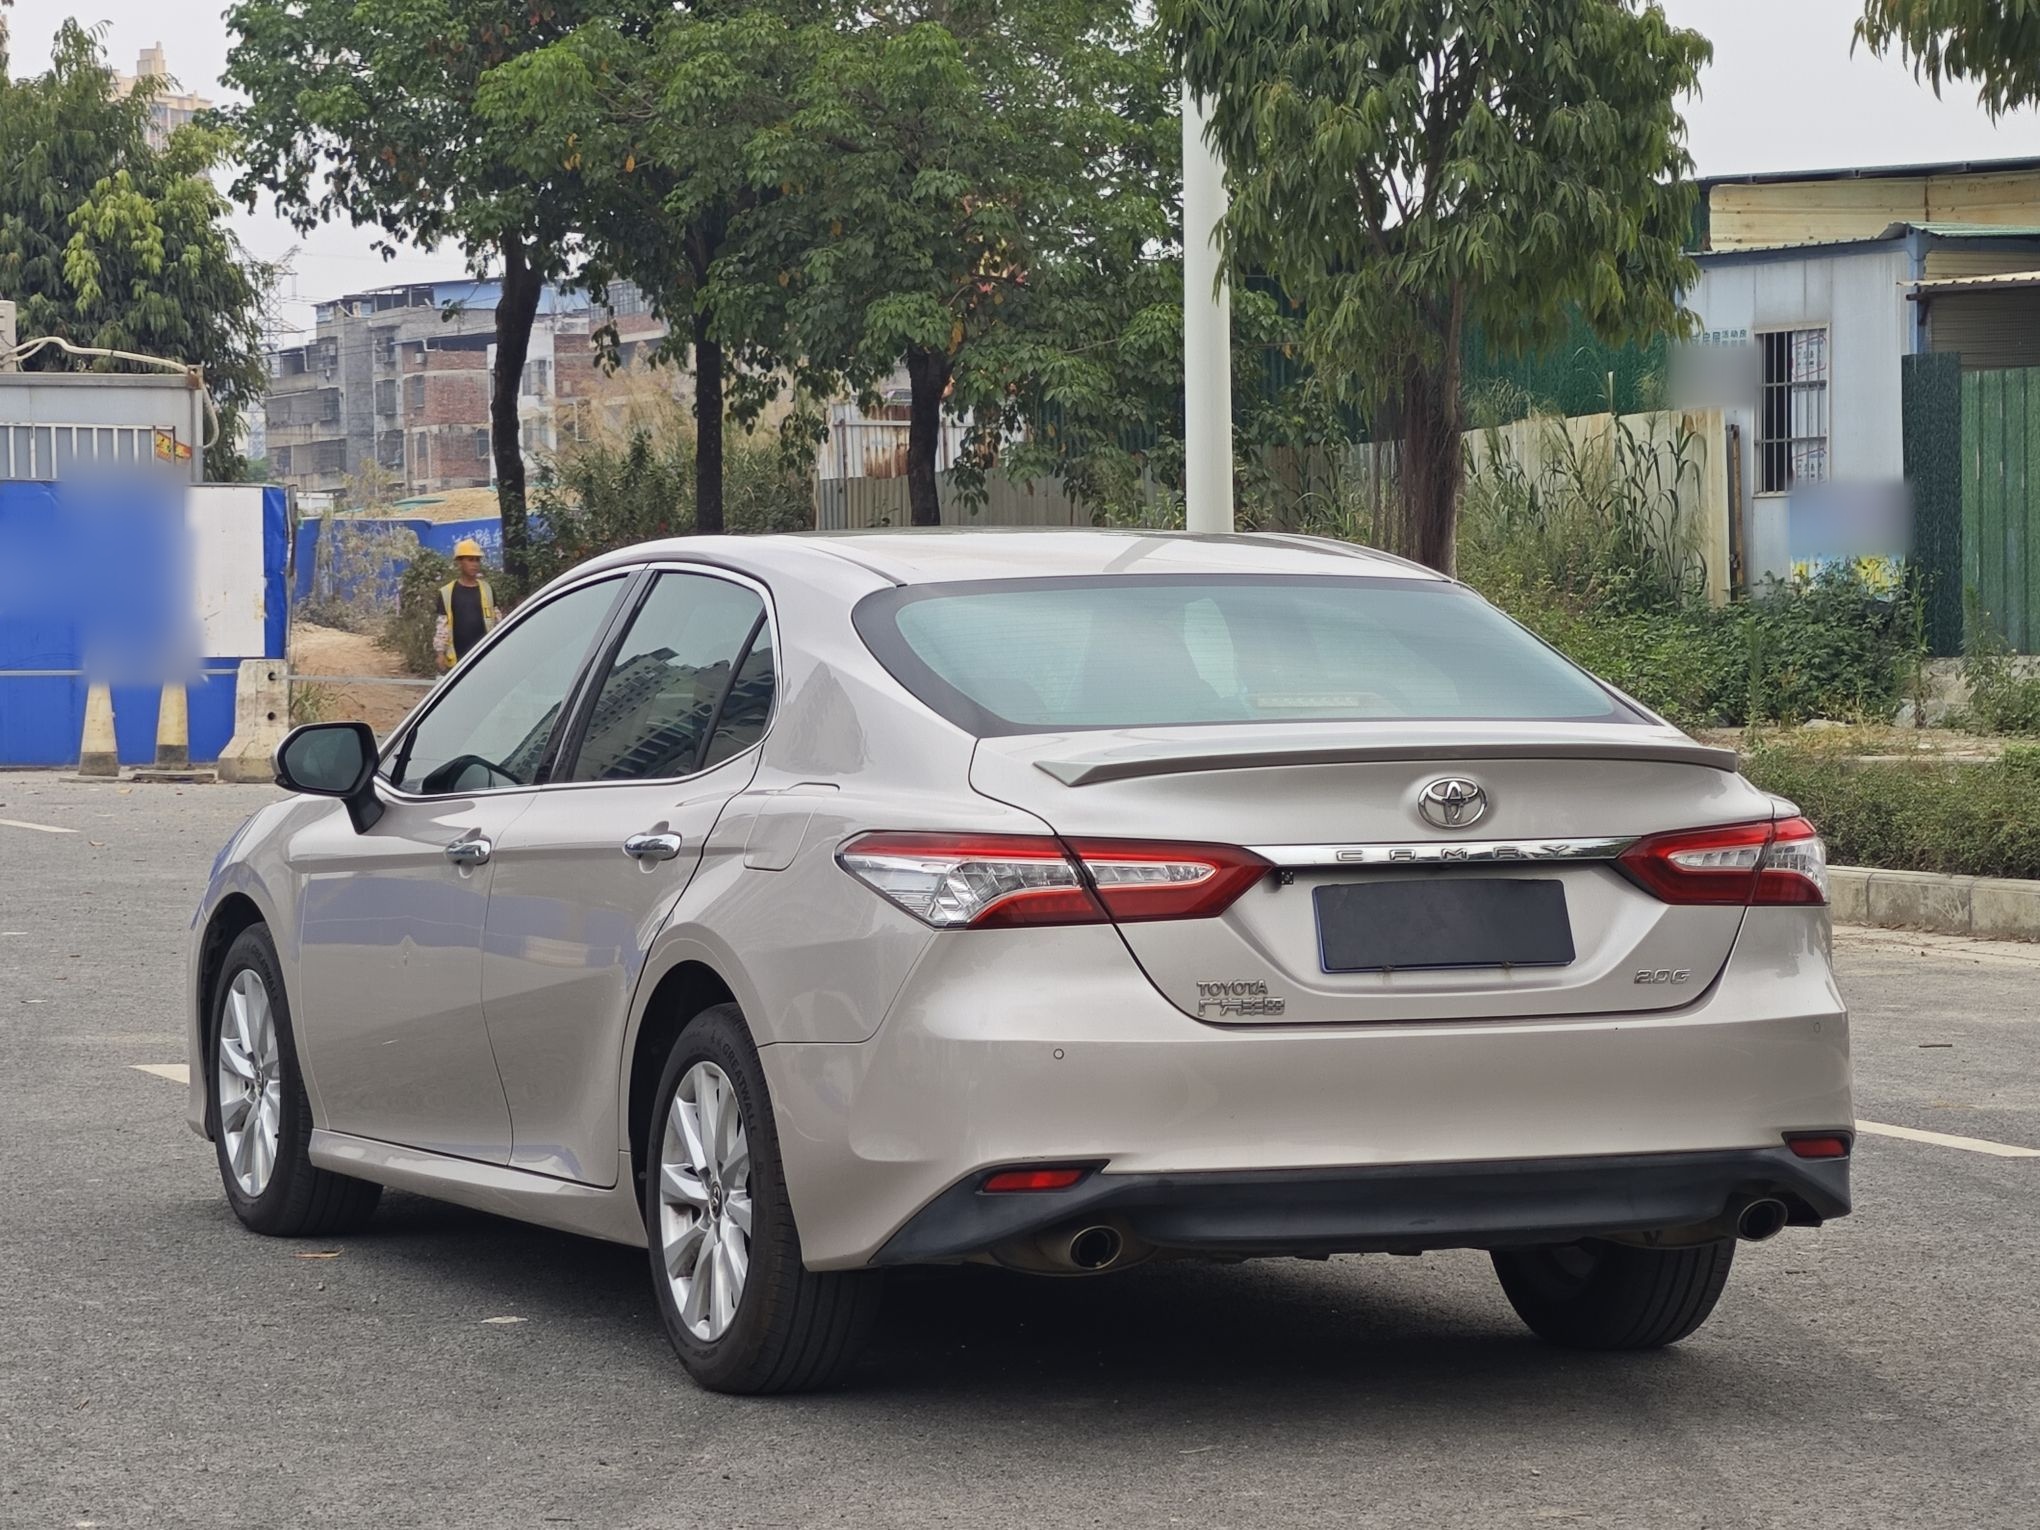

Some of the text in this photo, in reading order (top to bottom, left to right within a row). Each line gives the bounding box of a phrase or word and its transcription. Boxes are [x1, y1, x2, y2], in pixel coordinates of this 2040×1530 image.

[1336, 844, 1570, 862] CAMRY
[1196, 980, 1268, 996] TOYOTA
[1198, 997, 1285, 1017] 广汽丰田
